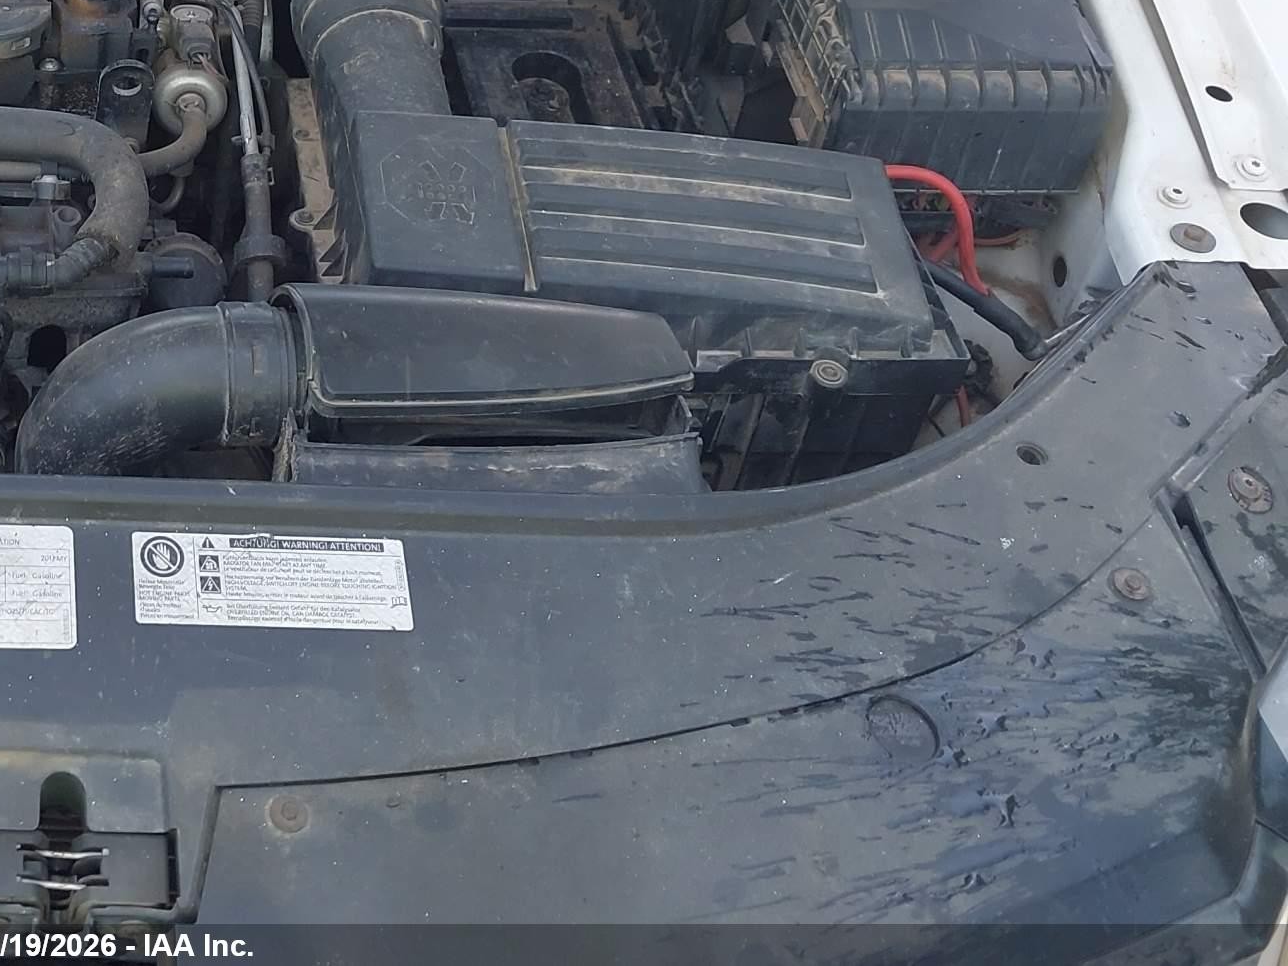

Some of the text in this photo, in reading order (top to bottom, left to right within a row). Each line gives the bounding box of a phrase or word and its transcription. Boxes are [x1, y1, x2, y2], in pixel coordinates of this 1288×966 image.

[233, 538, 382, 551] ACHTUNG! WARNING! ATTENTION!
